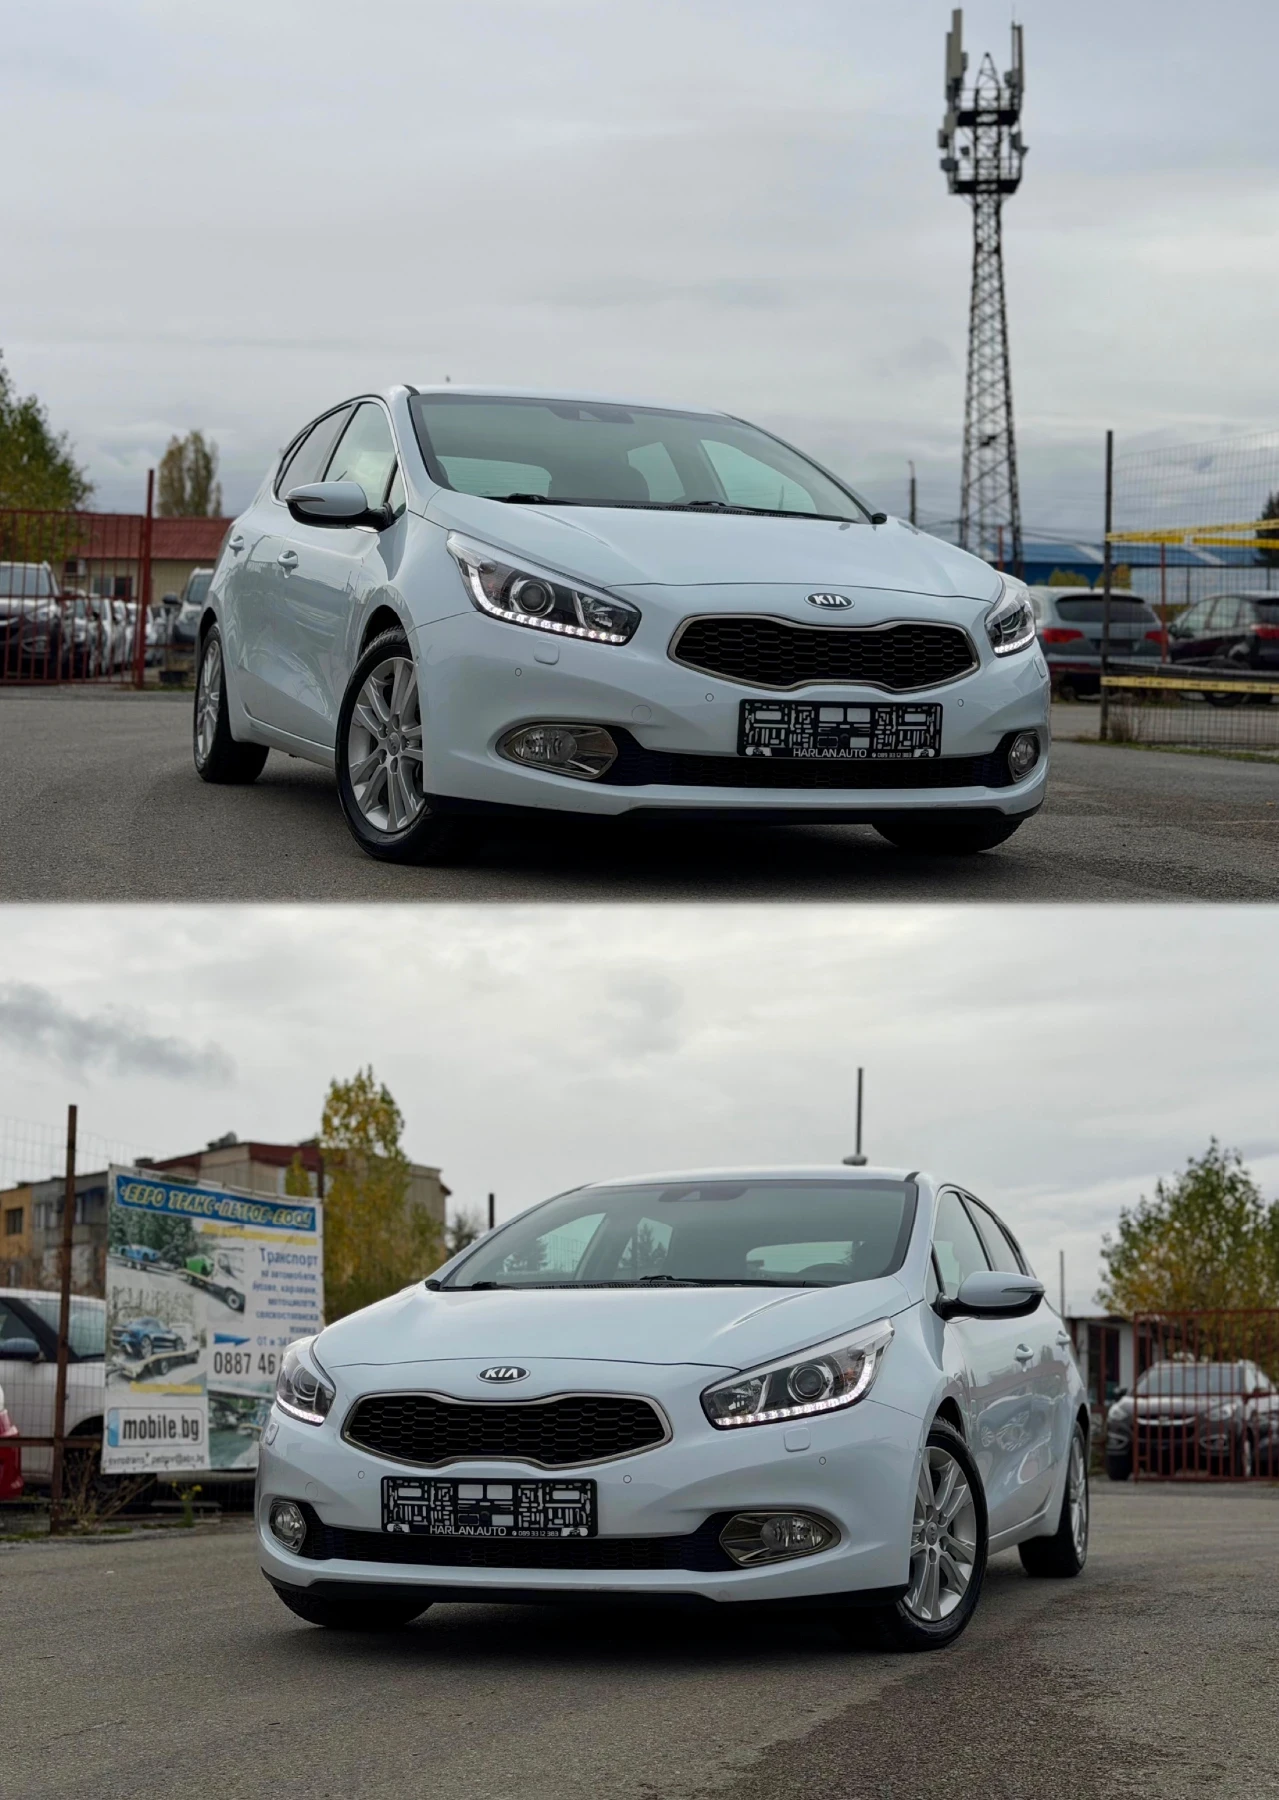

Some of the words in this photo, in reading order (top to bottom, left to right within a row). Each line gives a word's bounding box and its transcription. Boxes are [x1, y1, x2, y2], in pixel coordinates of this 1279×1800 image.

[812, 595, 848, 605] KIA
[793, 748, 867, 758] HARLAN.AUTO
[260, 1247, 318, 1268] Транспорт
[214, 1351, 252, 1374] 0887
[485, 1368, 518, 1378] KIA
[123, 1414, 199, 1441] mobile.bg
[429, 1525, 507, 1536] HARLAN.AUTO
